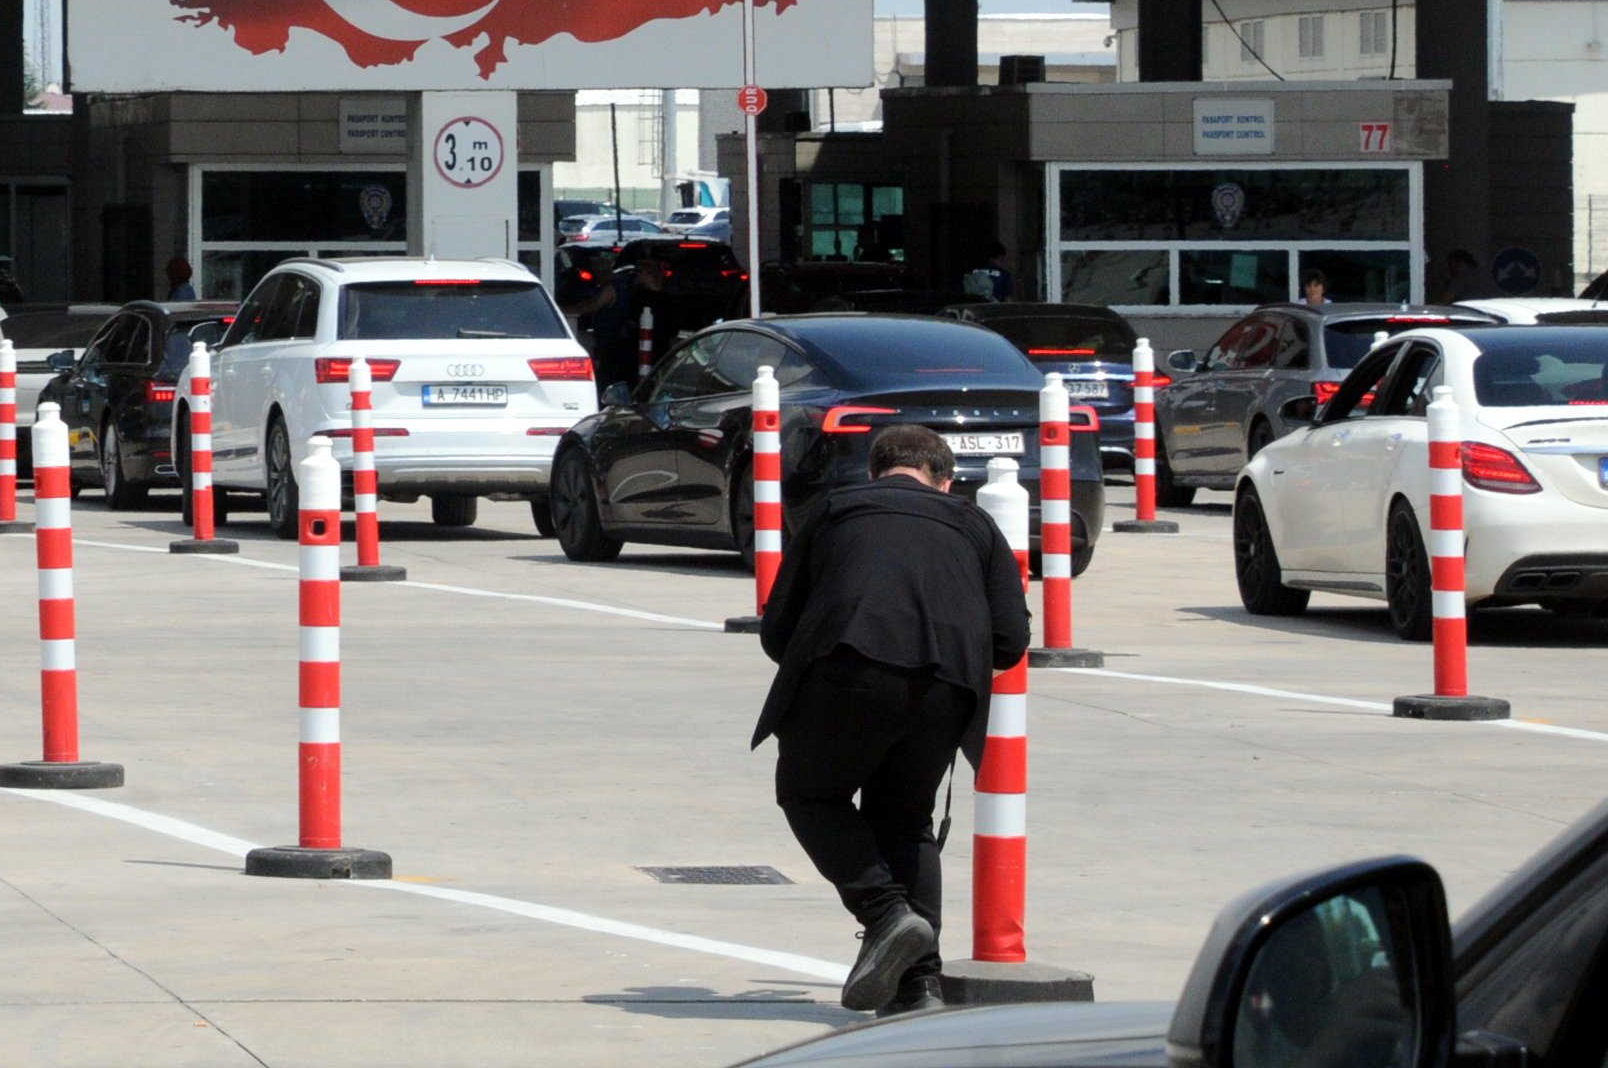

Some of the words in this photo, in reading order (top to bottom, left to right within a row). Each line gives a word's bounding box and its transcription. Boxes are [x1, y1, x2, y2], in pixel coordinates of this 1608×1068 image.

[745, 87, 758, 113] DUR
[380, 129, 406, 138] CONTRO
[1361, 124, 1389, 150] 77
[472, 140, 488, 150] m
[444, 133, 457, 171] 3
[437, 388, 446, 401] A
[931, 409, 1019, 417] TESLA
